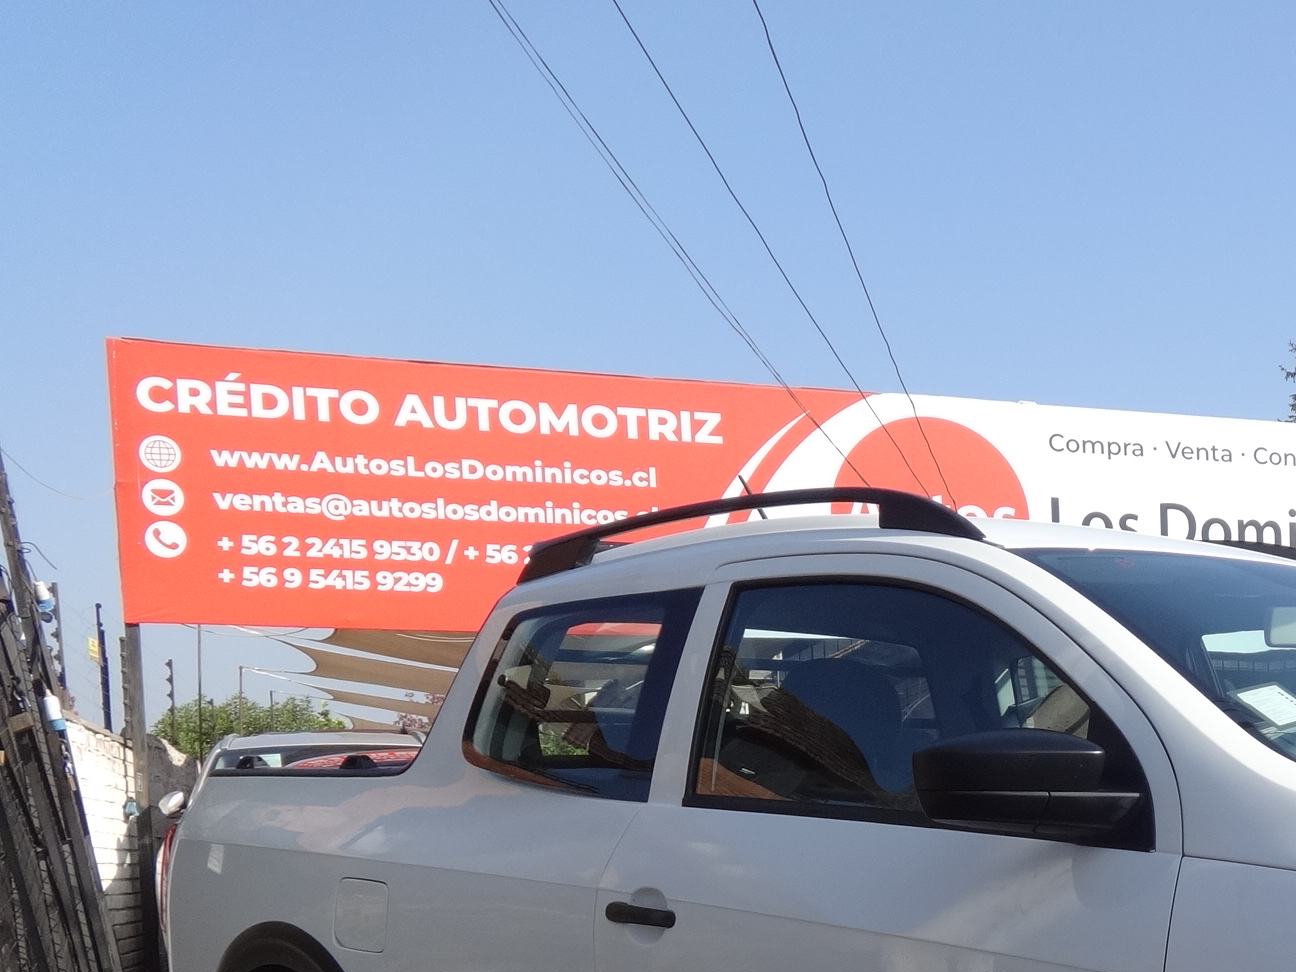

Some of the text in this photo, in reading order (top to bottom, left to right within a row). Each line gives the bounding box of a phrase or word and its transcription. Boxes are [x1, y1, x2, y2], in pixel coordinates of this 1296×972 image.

[135, 372, 724, 445] CRÉDITO AUTOMOTRIZ
[1048, 433, 1144, 460] Compra
[1165, 440, 1232, 463] Venta
[210, 449, 657, 488] www.AutosLosDominicos.cl
[212, 492, 659, 526] ventas@autoslosdominicos
[240, 534, 278, 556] 56
[281, 536, 301, 557] 2
[304, 537, 369, 560] 2415
[372, 539, 441, 562] 9530
[484, 543, 519, 565] 56
[241, 566, 279, 588] 56
[282, 567, 303, 589] 9
[307, 568, 371, 590] 5415
[375, 571, 444, 593] 9299
